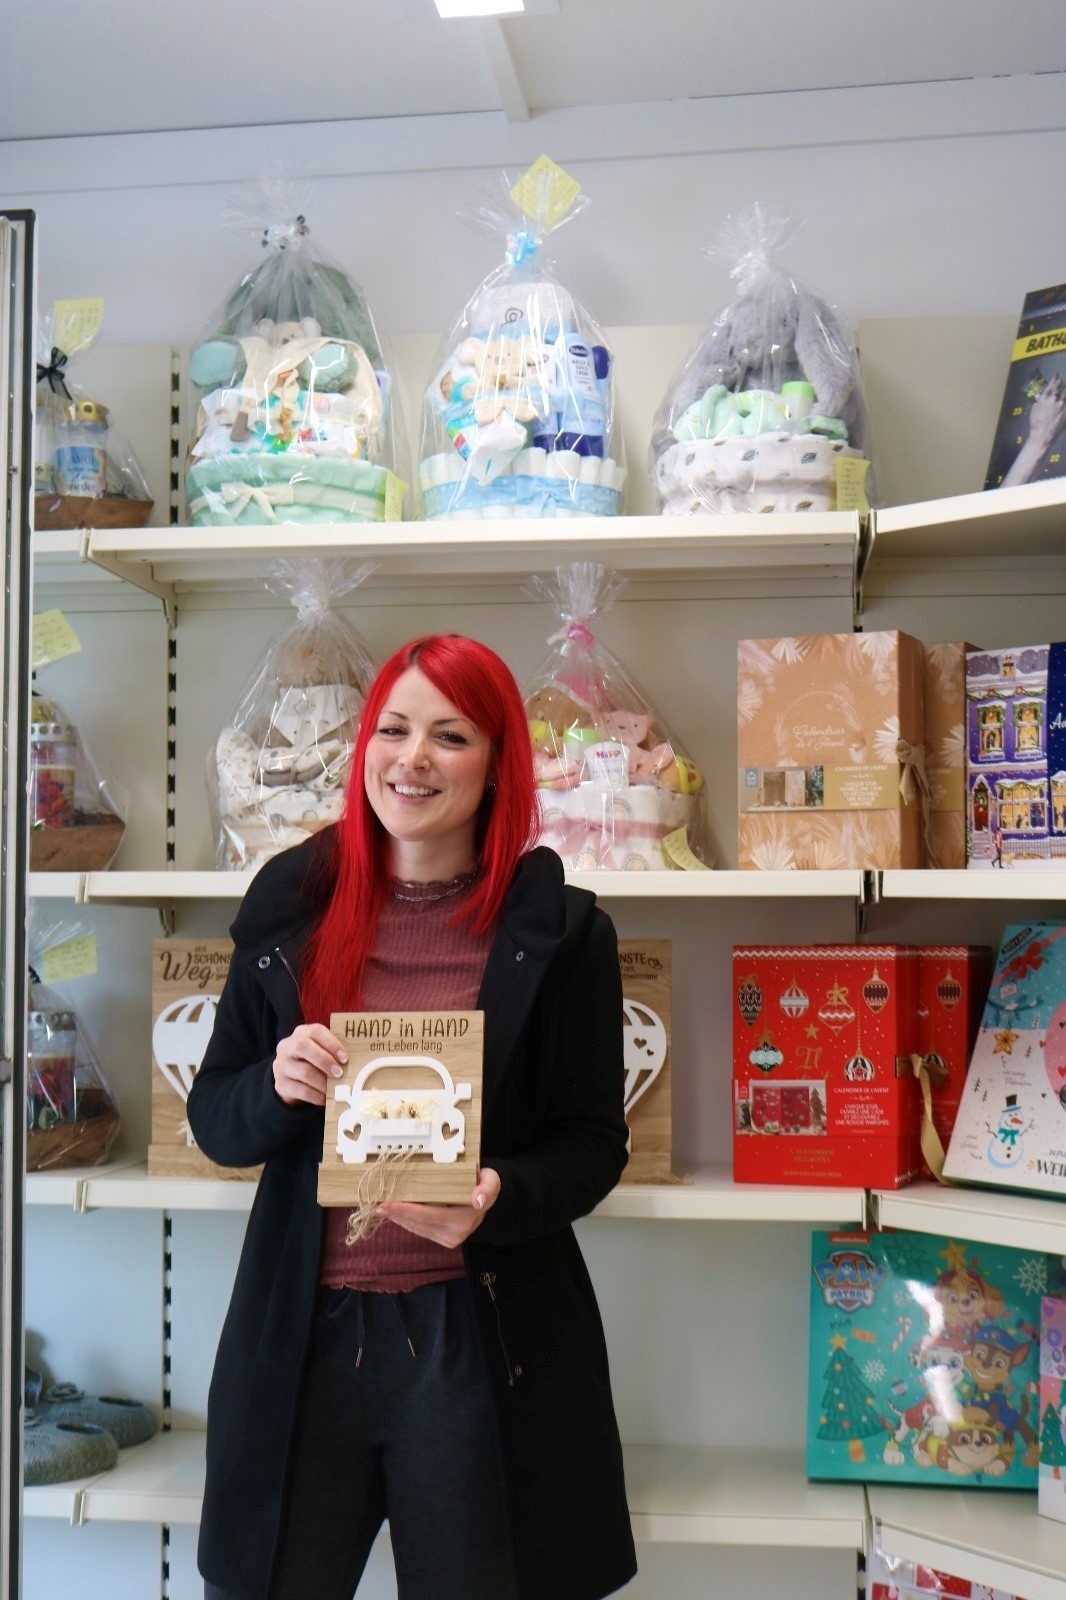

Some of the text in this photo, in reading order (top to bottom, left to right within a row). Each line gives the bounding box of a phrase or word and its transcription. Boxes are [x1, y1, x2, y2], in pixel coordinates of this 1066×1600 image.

[193, 952, 231, 965] SCHÖNS
[620, 952, 647, 964] NSTE
[160, 951, 215, 989] Weg
[345, 1018, 469, 1038] HAND in HAND
[370, 1039, 442, 1053] ein Leben lang
[814, 1260, 888, 1289] PAW
[830, 1290, 870, 1300] PATROL
